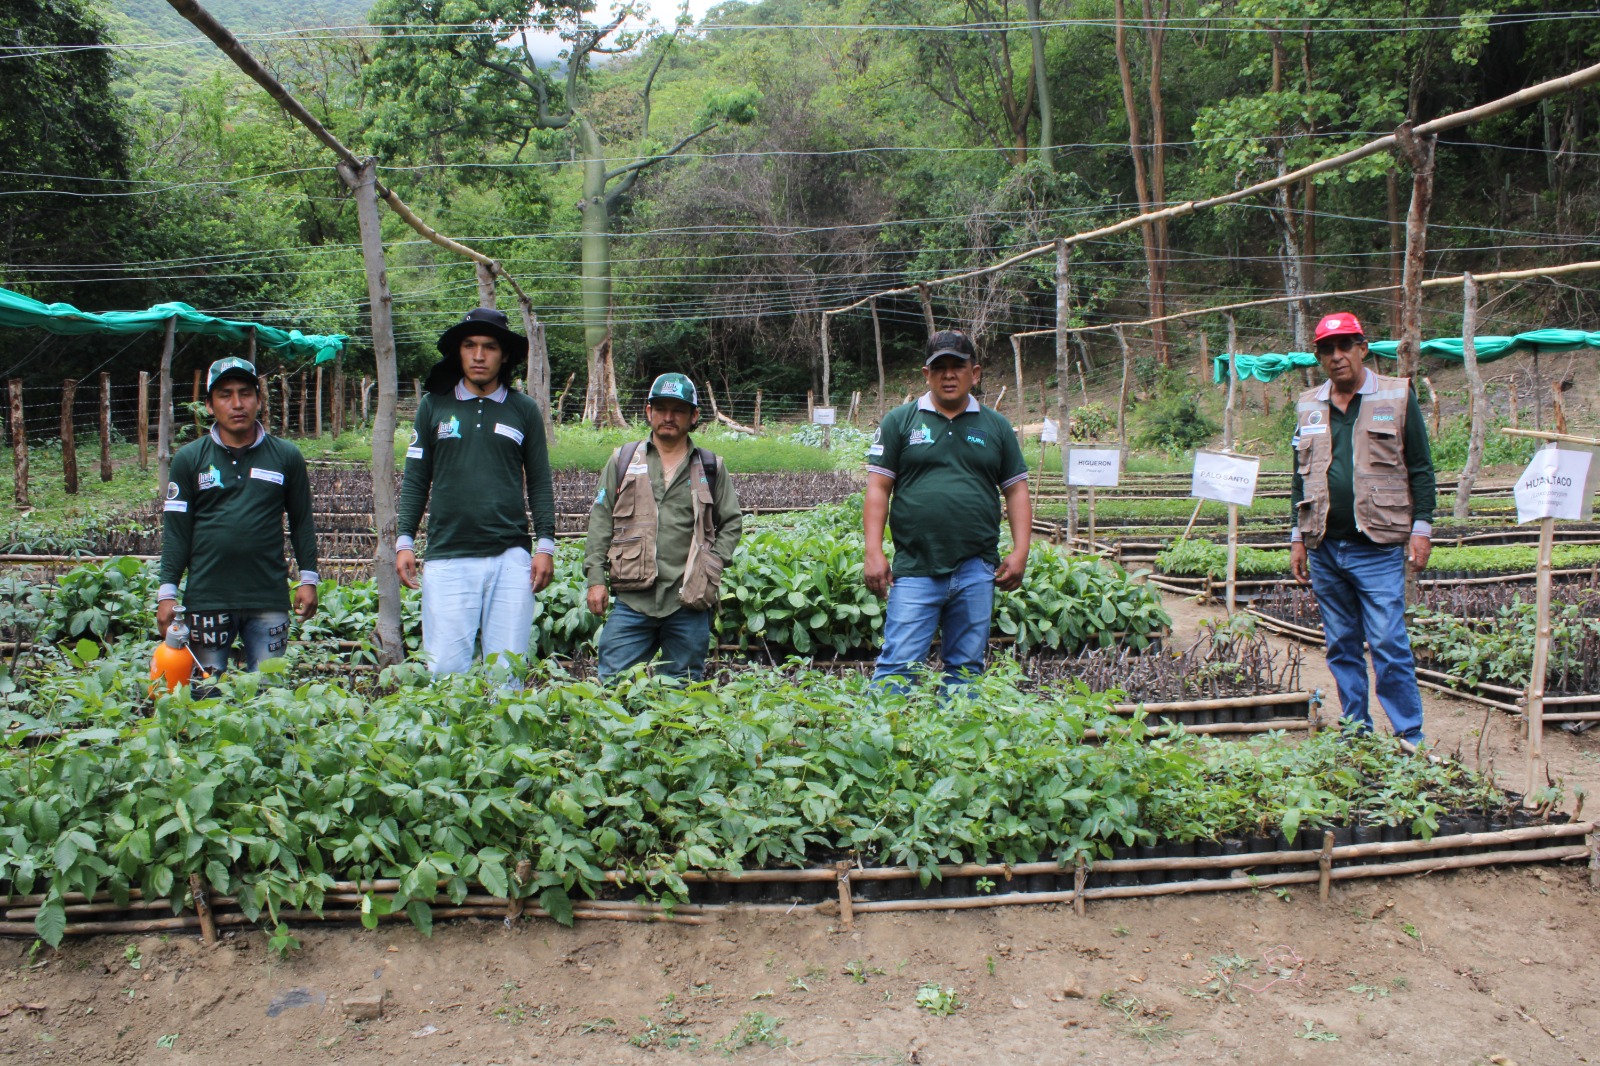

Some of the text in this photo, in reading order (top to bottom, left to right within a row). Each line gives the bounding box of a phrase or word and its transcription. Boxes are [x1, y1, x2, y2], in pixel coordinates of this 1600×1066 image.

[967, 435, 985, 445] PIURA
[1200, 470, 1250, 484] PALO SANTO
[1526, 476, 1572, 490] HUALTACO
[191, 613, 230, 628] THE
[190, 629, 229, 645] END
